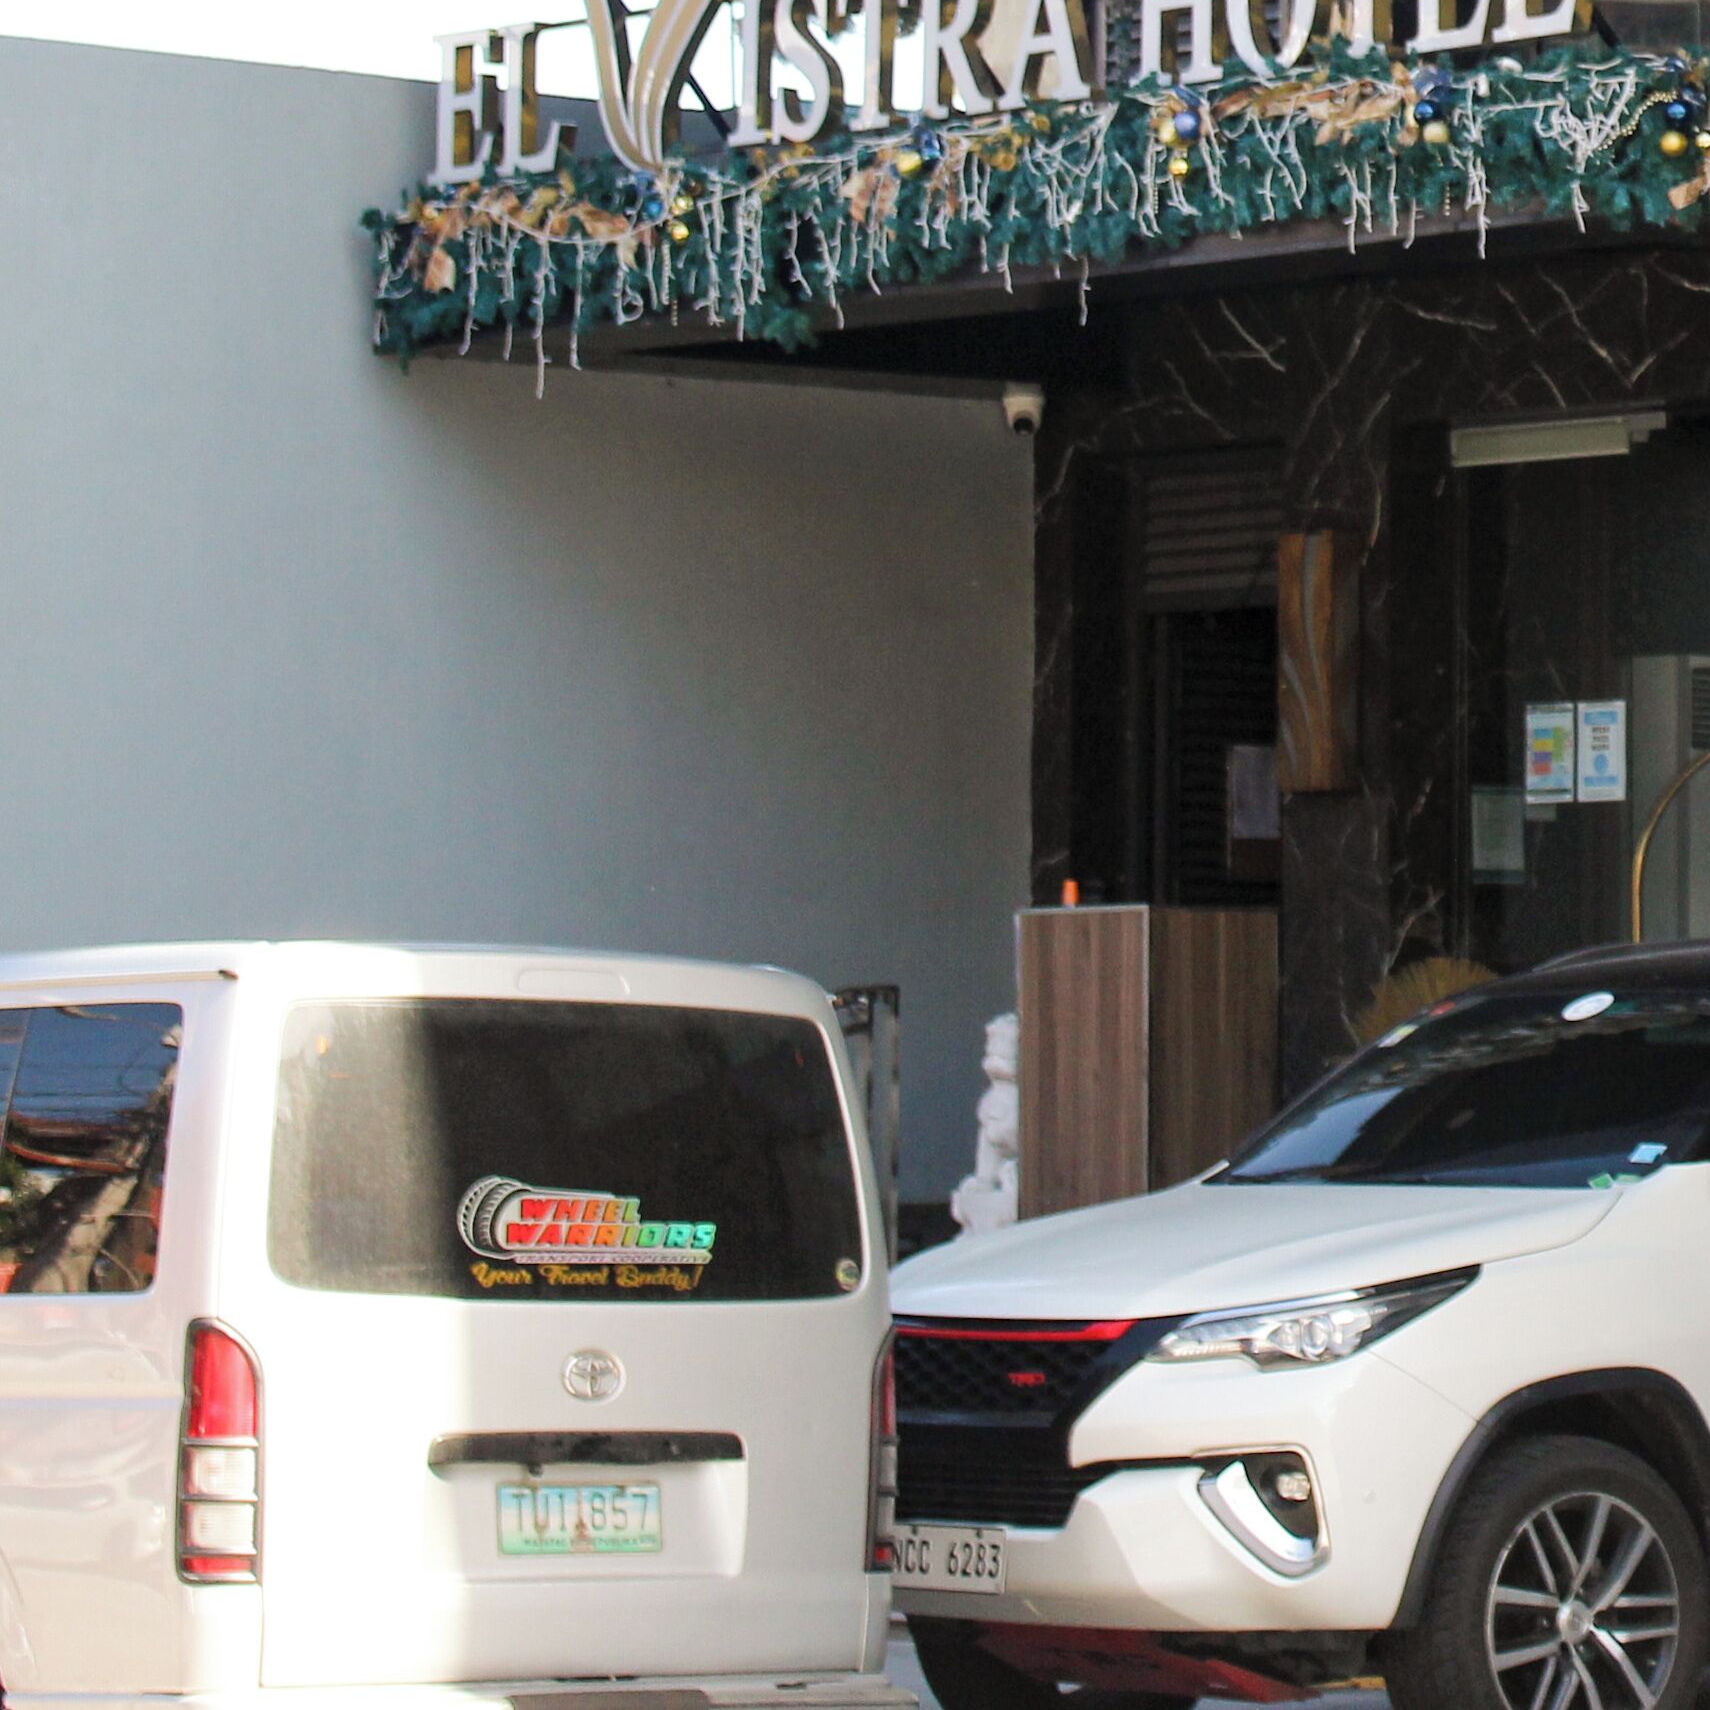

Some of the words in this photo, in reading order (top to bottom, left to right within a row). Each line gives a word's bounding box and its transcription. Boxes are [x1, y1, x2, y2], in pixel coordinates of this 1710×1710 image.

[428, 23, 574, 186] EL
[520, 1196, 641, 1223] WHEEL
[506, 1222, 717, 1250] WARRIORS
[470, 1261, 533, 1289] Your
[538, 1263, 609, 1287] Travel
[614, 1263, 704, 1291] Buddy!
[590, 1491, 649, 1531] 857
[892, 1538, 931, 1575] NCC
[947, 1541, 1001, 1579] 6283
